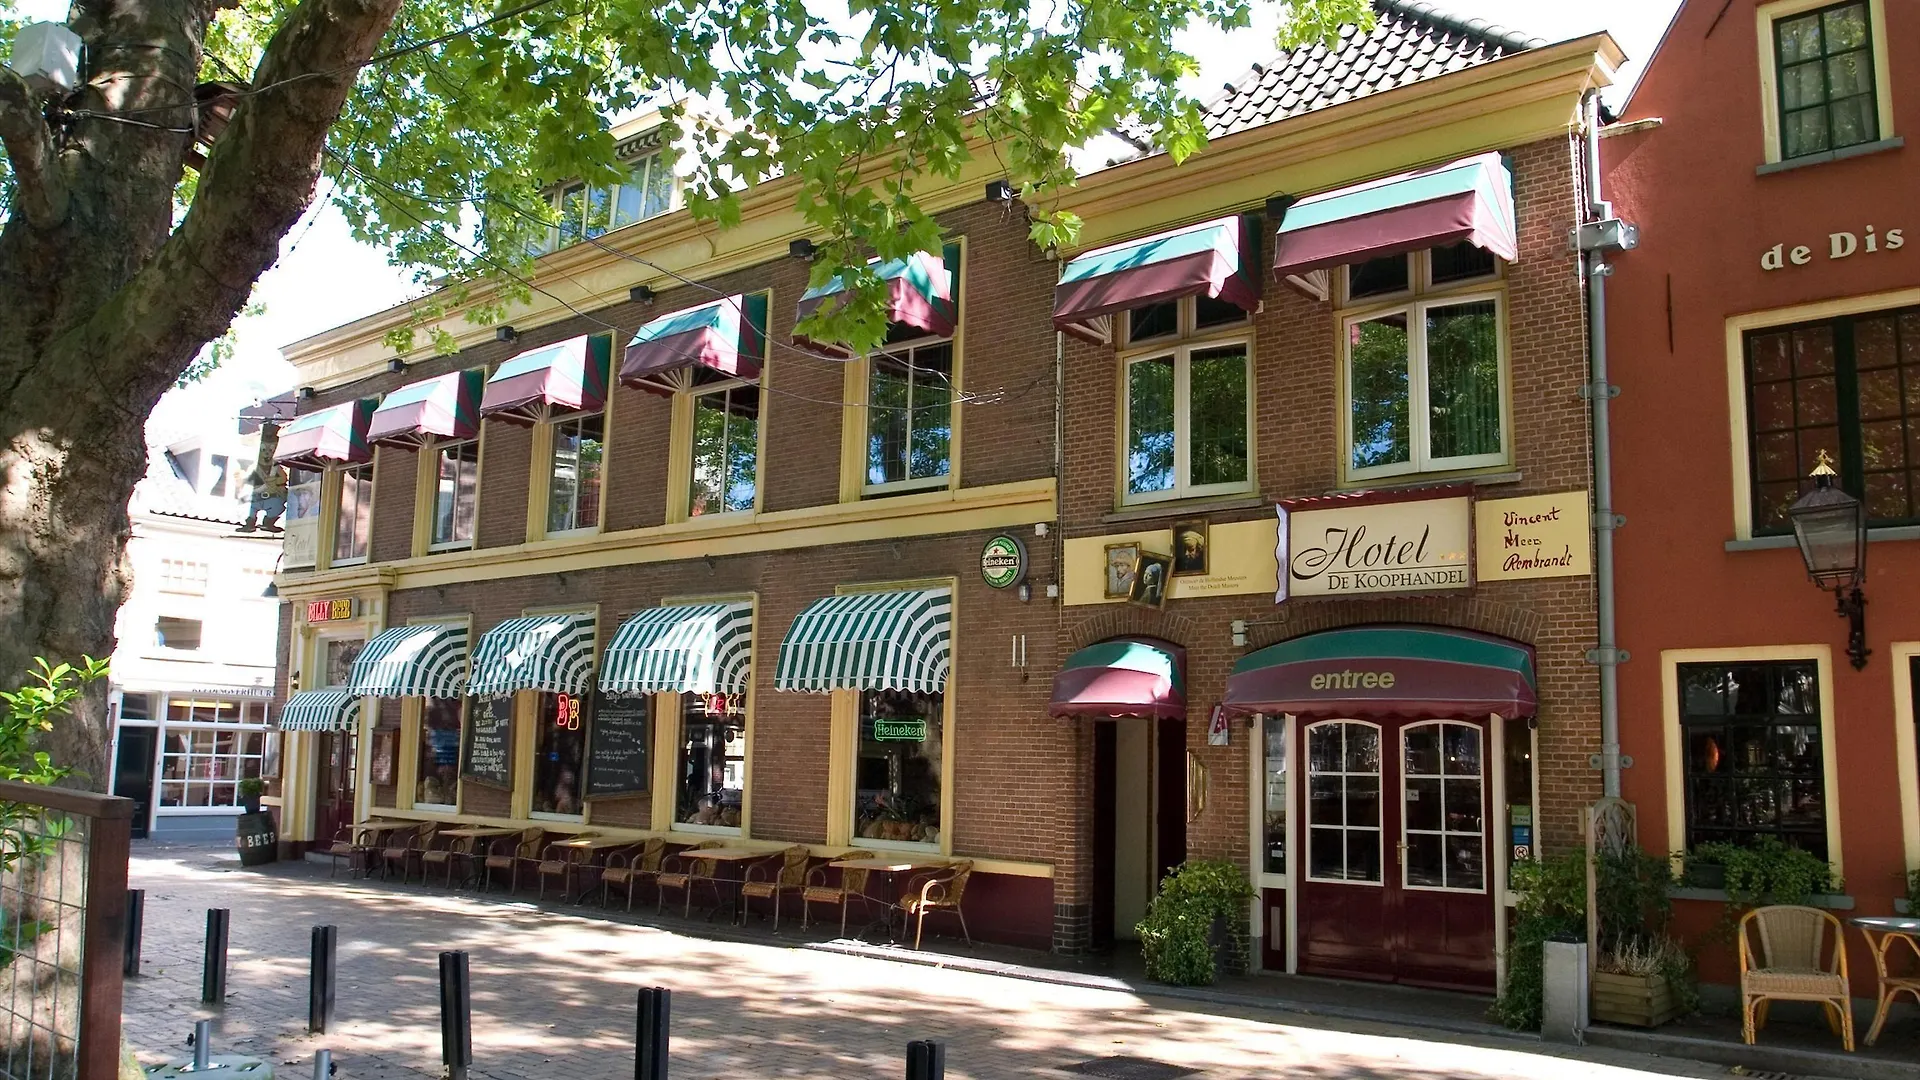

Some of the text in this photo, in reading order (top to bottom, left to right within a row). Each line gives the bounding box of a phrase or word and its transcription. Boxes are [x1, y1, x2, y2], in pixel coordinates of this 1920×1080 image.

[1761, 224, 1905, 271] de Dis
[1503, 506, 1563, 527] Vincent
[1291, 524, 1430, 580] Hotel
[1503, 544, 1573, 572] Rembrandt
[308, 599, 351, 622] BILLY BEER
[1310, 669, 1395, 690] entree
[877, 723, 925, 737] Heineken
[246, 831, 276, 848] BEER
